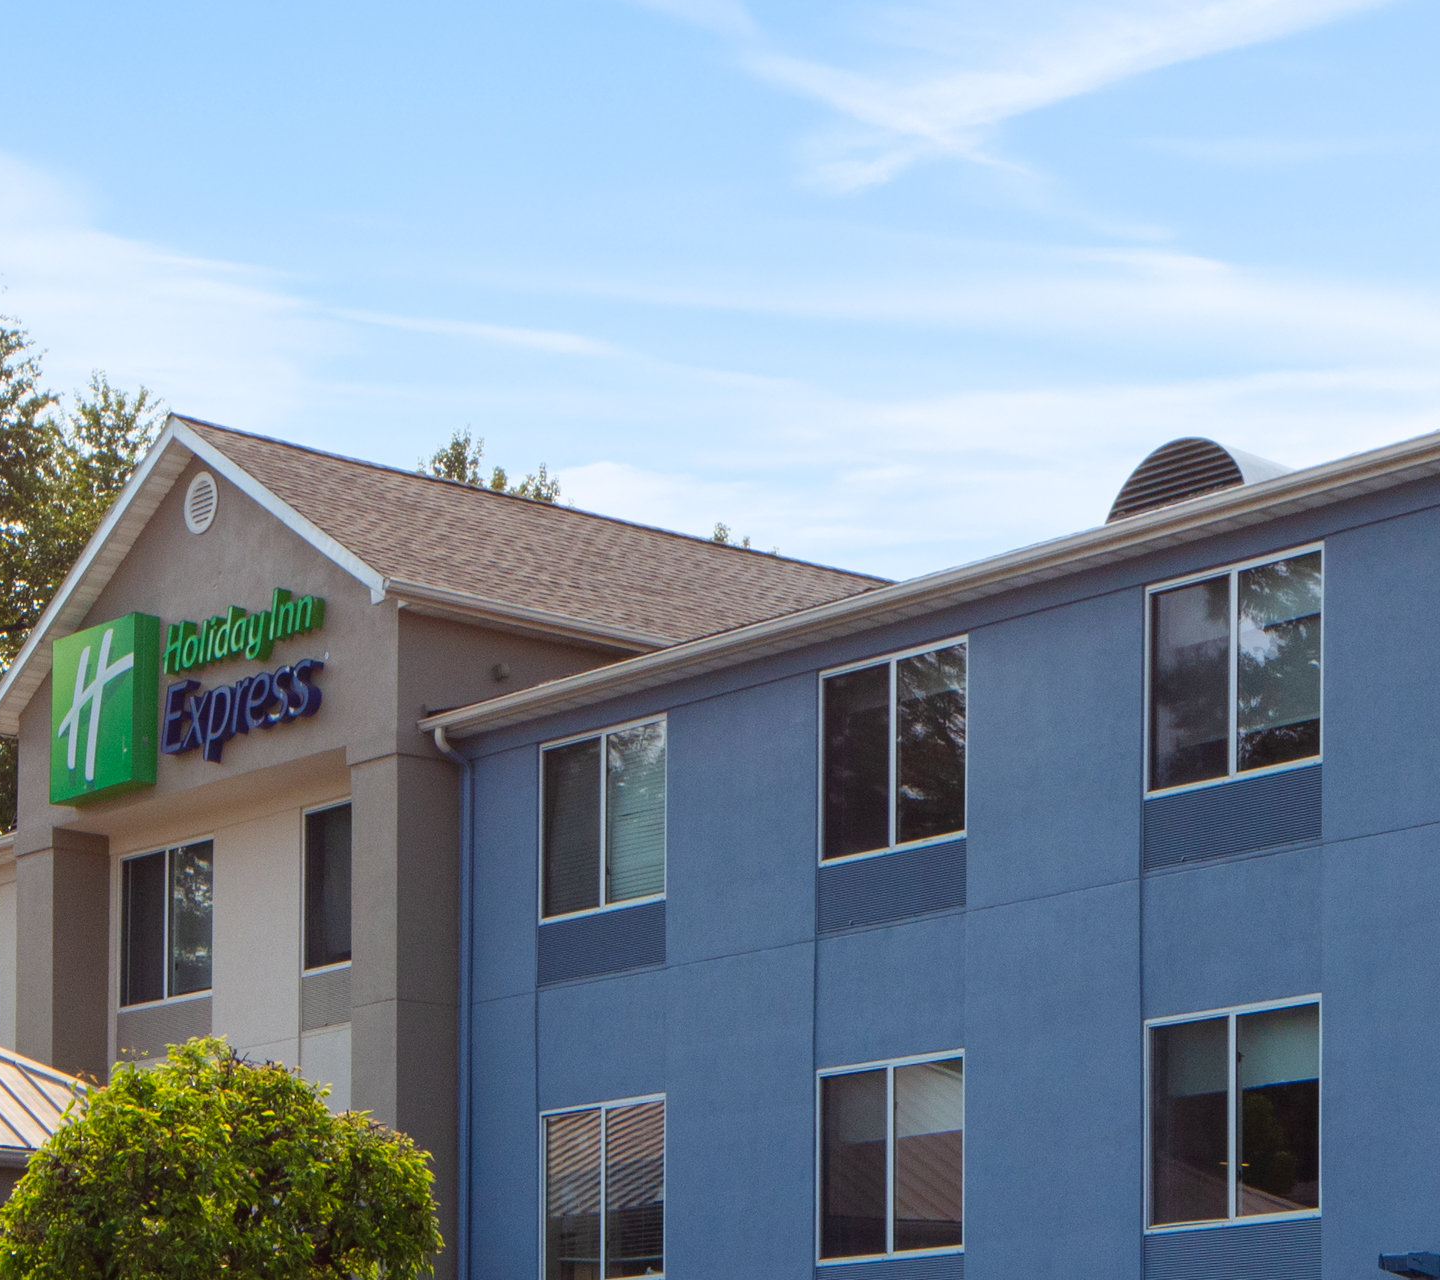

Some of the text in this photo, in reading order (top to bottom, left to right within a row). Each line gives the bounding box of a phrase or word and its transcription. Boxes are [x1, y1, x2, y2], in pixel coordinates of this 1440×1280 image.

[163, 587, 318, 675] Holiday Inn
[161, 658, 320, 761] Express
